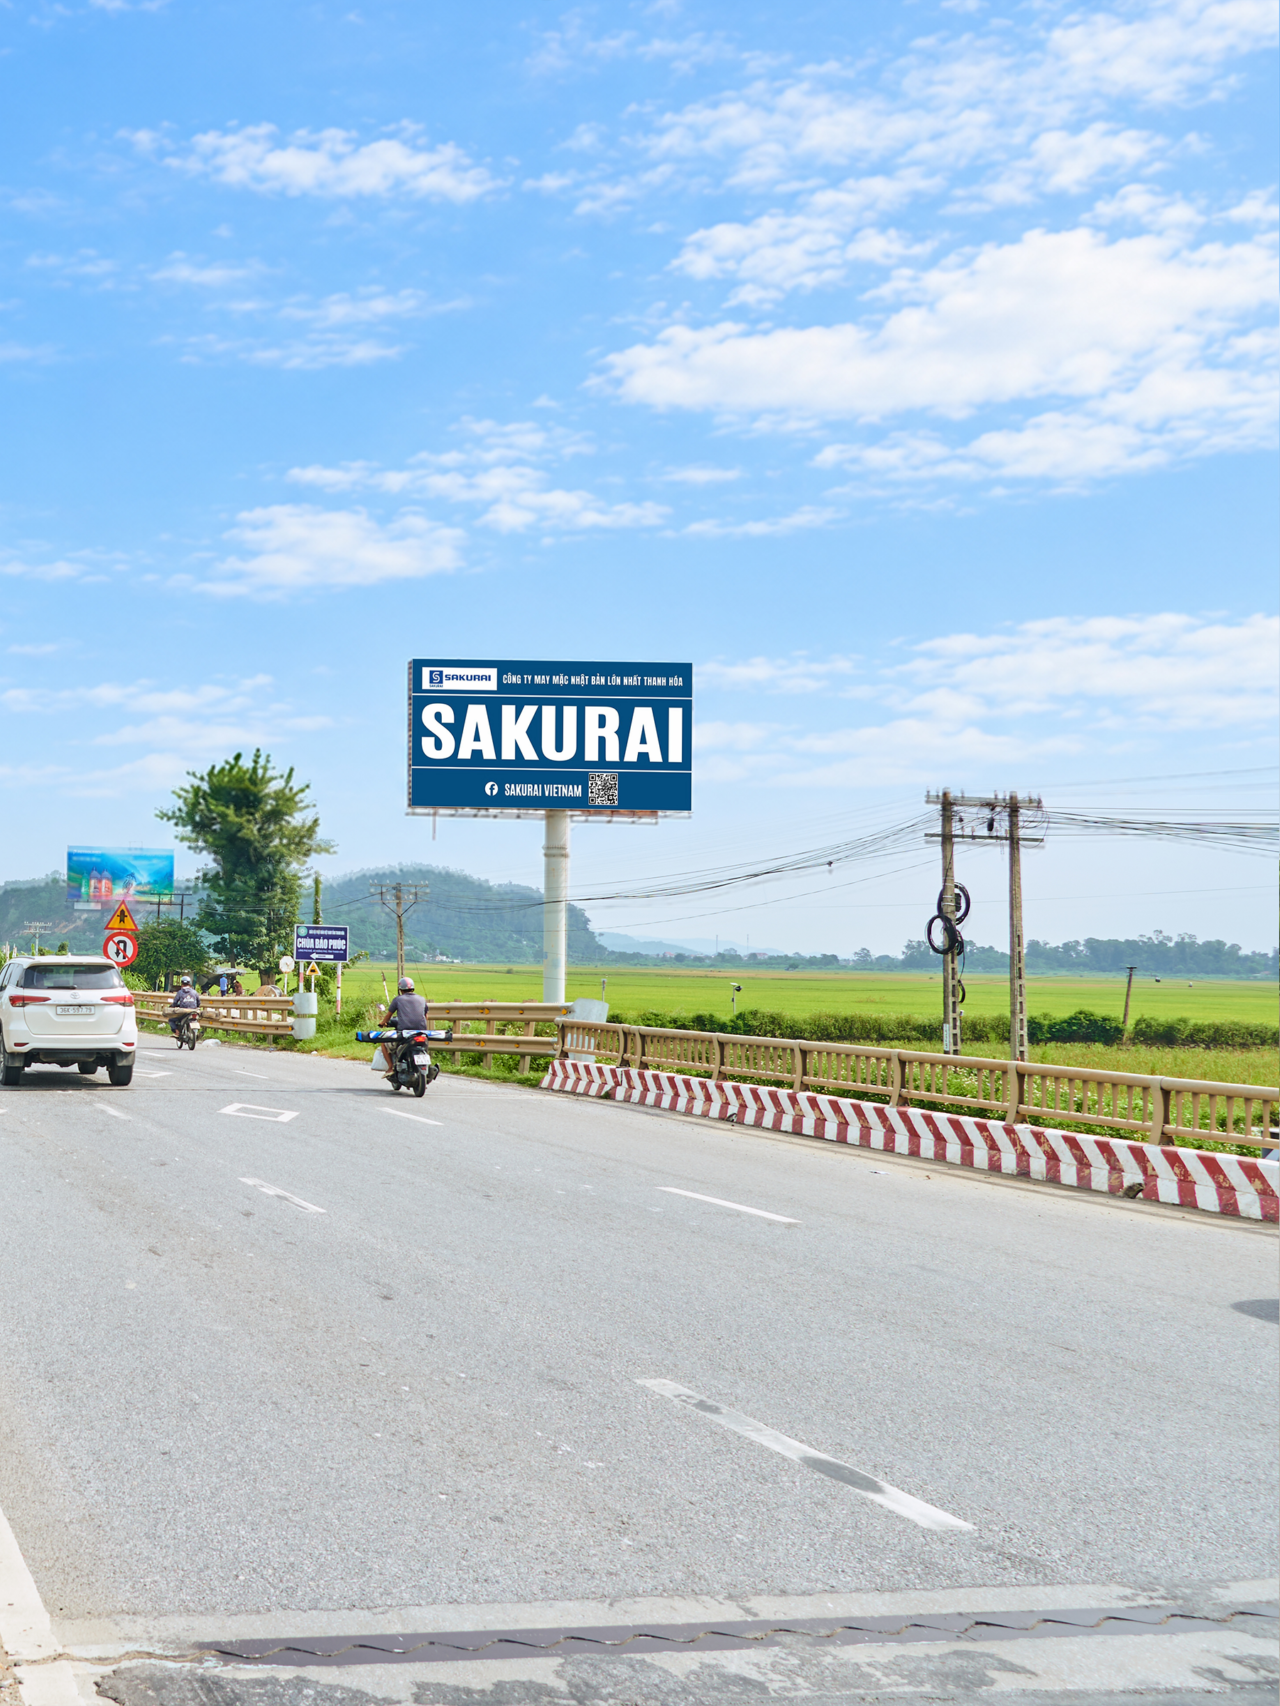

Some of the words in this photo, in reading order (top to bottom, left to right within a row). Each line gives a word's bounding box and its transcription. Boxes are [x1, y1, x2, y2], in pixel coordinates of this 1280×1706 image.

[444, 674, 492, 682] SAKURAI
[502, 672, 522, 685] CÔNG
[523, 675, 533, 684] TY
[534, 675, 551, 685] MAY
[552, 674, 569, 687] MẶC
[570, 673, 589, 687] NHẬT
[591, 673, 606, 686] BẢN
[607, 673, 621, 686] LỚN
[623, 674, 642, 686] NHẤT
[643, 676, 667, 687] THANH
[668, 675, 683, 687] HÓA
[421, 703, 683, 763] SAKURAI
[504, 783, 542, 797] SAKURAI
[544, 784, 582, 798] VIETNAM
